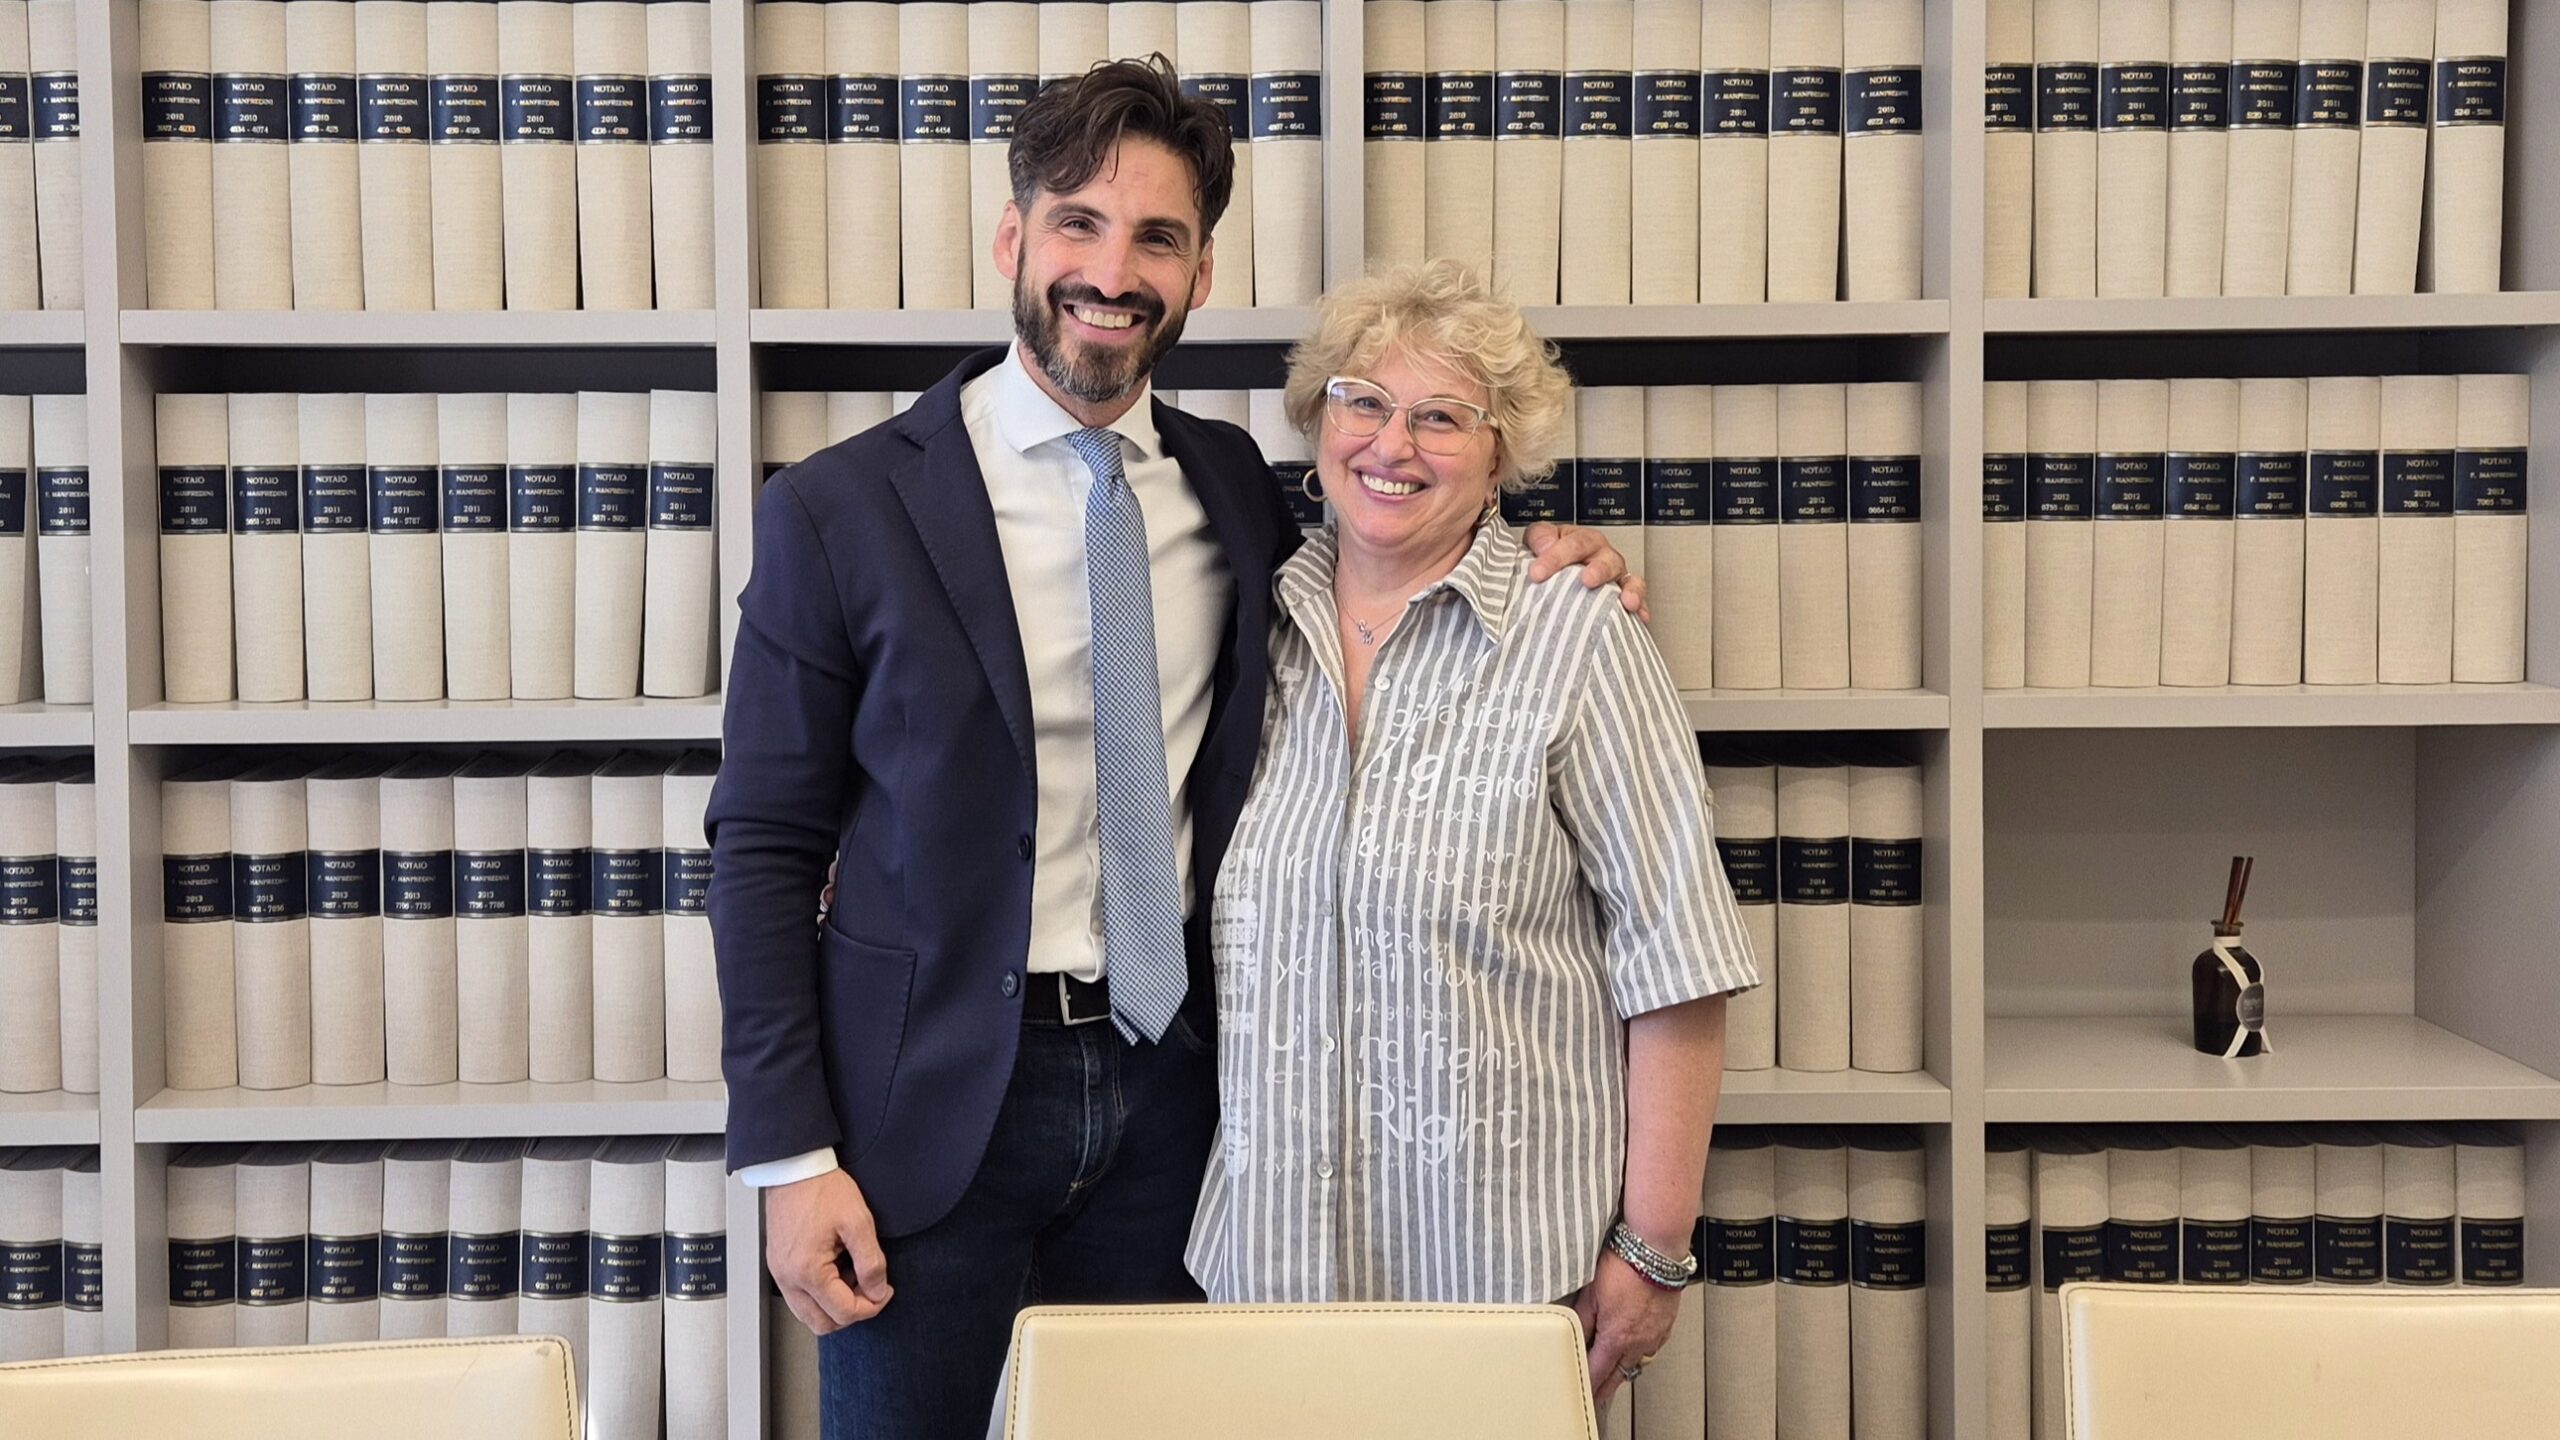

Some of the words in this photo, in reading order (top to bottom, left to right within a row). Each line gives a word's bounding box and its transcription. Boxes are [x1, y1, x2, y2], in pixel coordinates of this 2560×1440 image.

[2250, 70, 2283, 78] NOTAIO
[2317, 69, 2349, 78] NOTAIO
[2388, 67, 2419, 76] NOTAIO
[2458, 66, 2491, 74] NOTAIO
[1793, 76, 1824, 84] NOTAIO
[1869, 75, 1901, 84] NOTAIO
[1986, 72, 2015, 81] NOTAIO
[2055, 72, 2086, 80] NOTAIO
[2121, 72, 2153, 80] NOTAIO
[2183, 72, 2216, 81] NOTAIO
[159, 82, 192, 91] NOTAIO
[1270, 81, 1301, 90] NOTAIO
[1374, 82, 1405, 90] NOTAIO
[1442, 81, 1474, 90] NOTAIO
[1511, 80, 1542, 89] NOTAIO
[1583, 81, 1614, 89] NOTAIO
[1656, 80, 1686, 88] NOTAIO
[1723, 78, 1753, 87] NOTAIO
[232, 83, 265, 92] NOTAIO
[304, 83, 336, 91] NOTAIO
[377, 84, 409, 92] NOTAIO
[446, 84, 478, 93] NOTAIO
[519, 84, 551, 93] NOTAIO
[593, 85, 625, 93] NOTAIO
[667, 84, 698, 93] NOTAIO
[773, 84, 804, 92] NOTAIO
[845, 83, 877, 91] NOTAIO
[917, 84, 949, 93] NOTAIO
[988, 84, 1019, 92] NOTAIO
[239, 114, 258, 122] 2010
[312, 113, 330, 121] 2010
[453, 115, 471, 123] 2010
[527, 115, 544, 123] 2010
[601, 115, 618, 123] 2010
[674, 114, 692, 123] 2010
[780, 114, 797, 122] 2010
[852, 113, 870, 121] 2010
[924, 115, 941, 123] 2010
[995, 114, 1016, 122] 2010
[1277, 111, 1295, 119] 2010
[2045, 463, 2077, 471] NOTAIO
[2116, 462, 2148, 470] NOTAIO
[2188, 462, 2220, 470] NOTAIO
[2406, 459, 2438, 467] NOTAIO
[1661, 468, 1692, 476] NOTAIO
[1730, 467, 1761, 475] NOTAIO
[1801, 466, 1831, 474] NOTAIO
[1871, 466, 1903, 474] NOTAIO
[174, 476, 205, 484] NOTAIO
[315, 475, 348, 483] NOTAIO
[385, 476, 417, 484] NOTAIO
[456, 474, 488, 483] NOTAIO
[525, 475, 556, 483] NOTAIO
[595, 473, 627, 481] NOTAIO
[664, 472, 695, 480] NOTAIO
[52, 477, 83, 485] NOTAIO
[246, 477, 279, 485] NOTAIO
[392, 506, 409, 514] 2011
[463, 505, 480, 513] 2011
[531, 505, 548, 513] 2011
[669, 502, 685, 510] 2011
[254, 507, 271, 515] 2011
[1358, 826, 1381, 857] &
[324, 861, 356, 869] NOTAIO
[398, 861, 428, 869] NOTAIO
[470, 861, 501, 869] NOTAIO
[543, 859, 573, 867] NOTAIO
[610, 859, 640, 867] NOTAIO
[4, 866, 34, 875] NOTAIO
[71, 867, 96, 876] NOTAI
[179, 864, 210, 873] NOTAIO
[249, 864, 280, 873] NOTAIO
[331, 891, 348, 899] 2013
[404, 891, 420, 900] 2013
[478, 891, 494, 899] 2013
[549, 889, 566, 897] 2013
[616, 889, 633, 897] 2013
[10, 897, 28, 905] 2013
[78, 898, 95, 906] 2013
[186, 895, 203, 903] 2013
[256, 894, 274, 903] 2013
[1420, 1030, 1521, 1085] fight
[1359, 1082, 1522, 1166] Right
[1800, 1230, 1831, 1238] NOTAIO
[1874, 1233, 1906, 1241] NOTAIO
[324, 1246, 355, 1254] NOTAIO
[397, 1242, 428, 1251] NOTAIO
[468, 1244, 499, 1252] NOTAIO
[539, 1242, 569, 1251] NOTAIO
[607, 1244, 638, 1253] NOTAIO
[683, 1243, 714, 1252] NOTAIO
[10, 1252, 41, 1261] NOTAIO
[252, 1248, 284, 1257] NOTAIO
